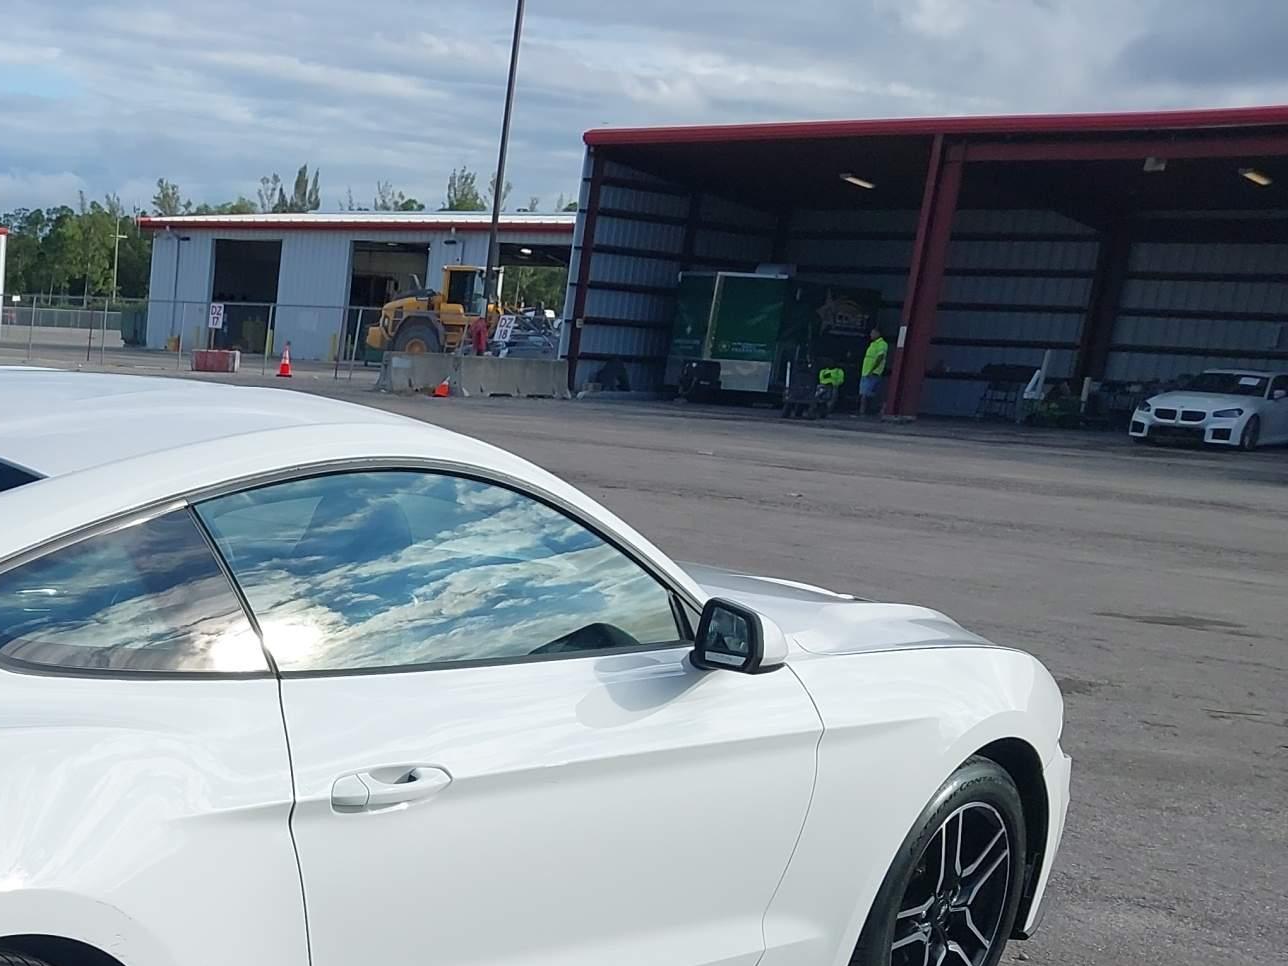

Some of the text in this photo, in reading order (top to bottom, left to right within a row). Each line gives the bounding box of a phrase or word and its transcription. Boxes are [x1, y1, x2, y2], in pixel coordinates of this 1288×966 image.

[211, 305, 223, 316] DZ
[212, 316, 220, 327] 17
[500, 317, 514, 328] DZ
[499, 329, 508, 339] 18
